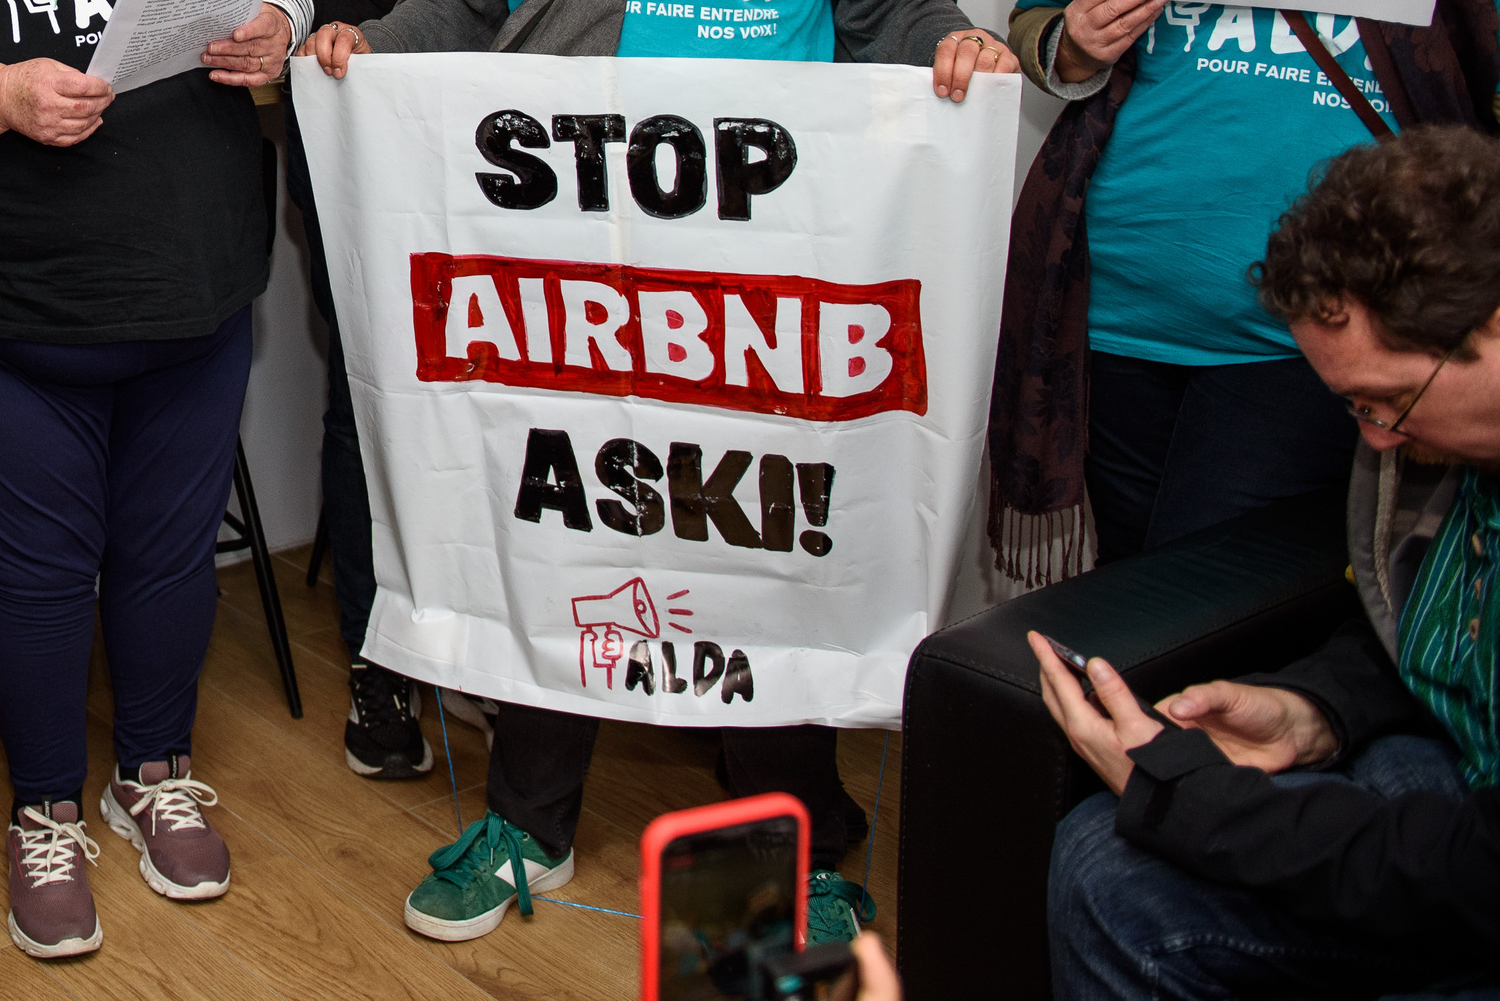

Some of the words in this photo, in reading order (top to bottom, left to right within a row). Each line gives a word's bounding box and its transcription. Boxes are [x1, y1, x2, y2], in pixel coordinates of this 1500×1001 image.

[646, 1, 695, 19] FAIRE
[700, 6, 779, 22] ENTENDRE
[697, 24, 735, 40] NOS
[1196, 57, 1250, 75] POUR
[1254, 62, 1311, 83] FAIRE
[1312, 91, 1352, 110] NOS
[474, 108, 798, 221] STOP
[444, 274, 894, 398] AIRBNB
[513, 428, 836, 558] ASKI!
[624, 638, 755, 704] ALDA
